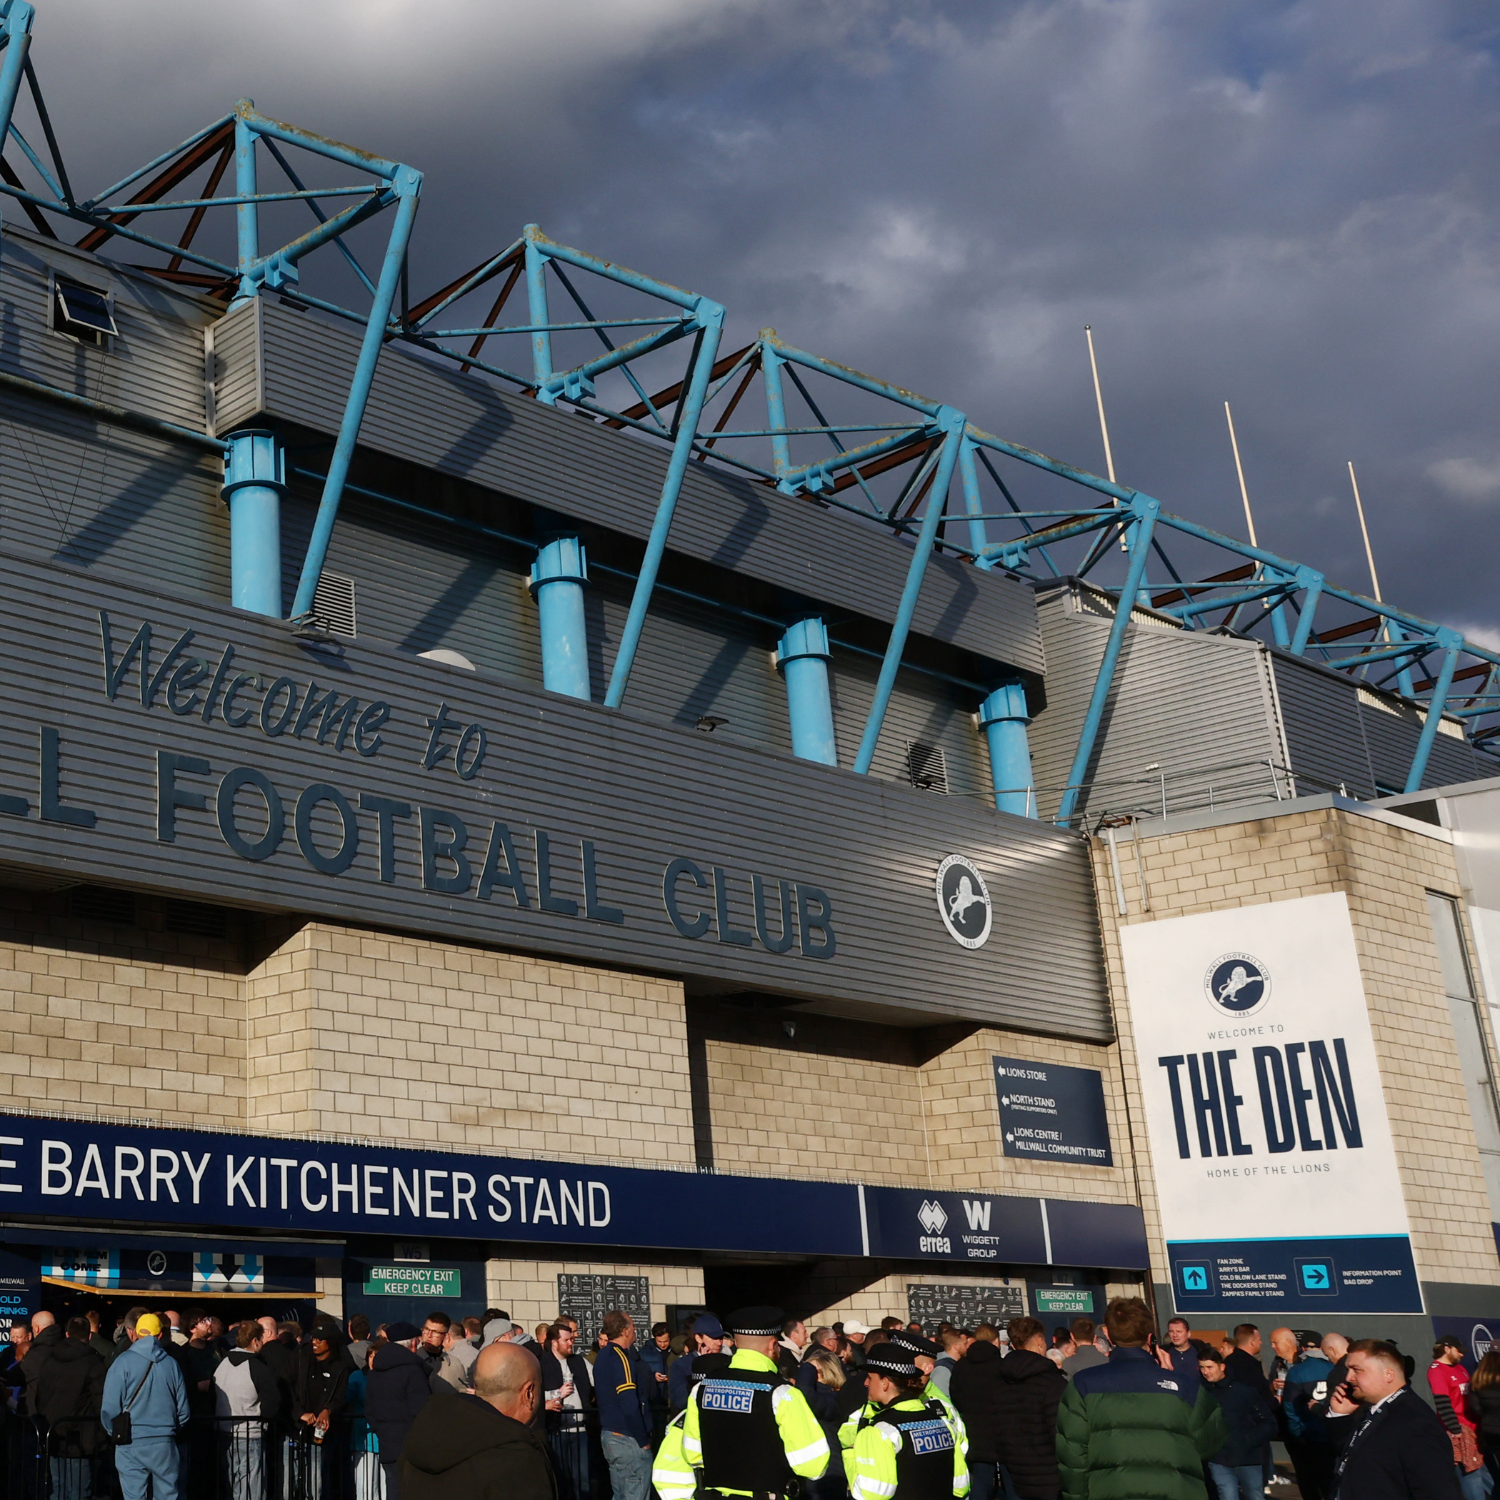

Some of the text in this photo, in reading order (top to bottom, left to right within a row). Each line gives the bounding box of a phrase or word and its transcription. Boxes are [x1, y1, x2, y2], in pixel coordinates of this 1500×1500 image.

[98, 609, 486, 780] Welcome to
[155, 750, 624, 925] FOOTBALL
[661, 857, 837, 959] CLUB
[937, 859, 952, 895] MILLWALL
[951, 855, 980, 882] FOOTBALL
[1205, 953, 1269, 989] MILLWALL FOOTBALL CLUB
[1234, 1010, 1250, 1018] 1885
[1207, 1024, 1284, 1040] WELCOME TO
[1006, 1067, 1047, 1081] LIONS STORE
[1009, 1093, 1056, 1108] NORTH STAND
[1158, 1037, 1364, 1160] THE DEN
[1013, 1127, 1033, 1138] LIONS
[1034, 1128, 1059, 1140] CENTRE
[1015, 1141, 1107, 1159] MILLWALL COMMUNITY TRUST
[1207, 1163, 1331, 1178] HOME OF THE LIONS
[41, 1140, 212, 1205] BARRY
[226, 1154, 477, 1223] KITCHENER
[486, 1172, 611, 1229] STAND
[962, 1234, 1000, 1245] WIGGETT
[402, 1244, 422, 1259] W5
[967, 1248, 997, 1258] GROUP
[60, 1261, 101, 1272] COME
[1342, 1269, 1383, 1277] INFORMATION
[371, 1268, 454, 1282] EMERGENCY EXIT
[384, 1282, 444, 1295] KEEP CLEAR
[1040, 1291, 1088, 1301] EMERGENCY EXIT
[1048, 1302, 1084, 1311] KEEP CLEAR
[706, 1387, 751, 1397] METROPOLITAN
[704, 1393, 750, 1411] POLICE
[914, 1432, 953, 1452] POLICE
